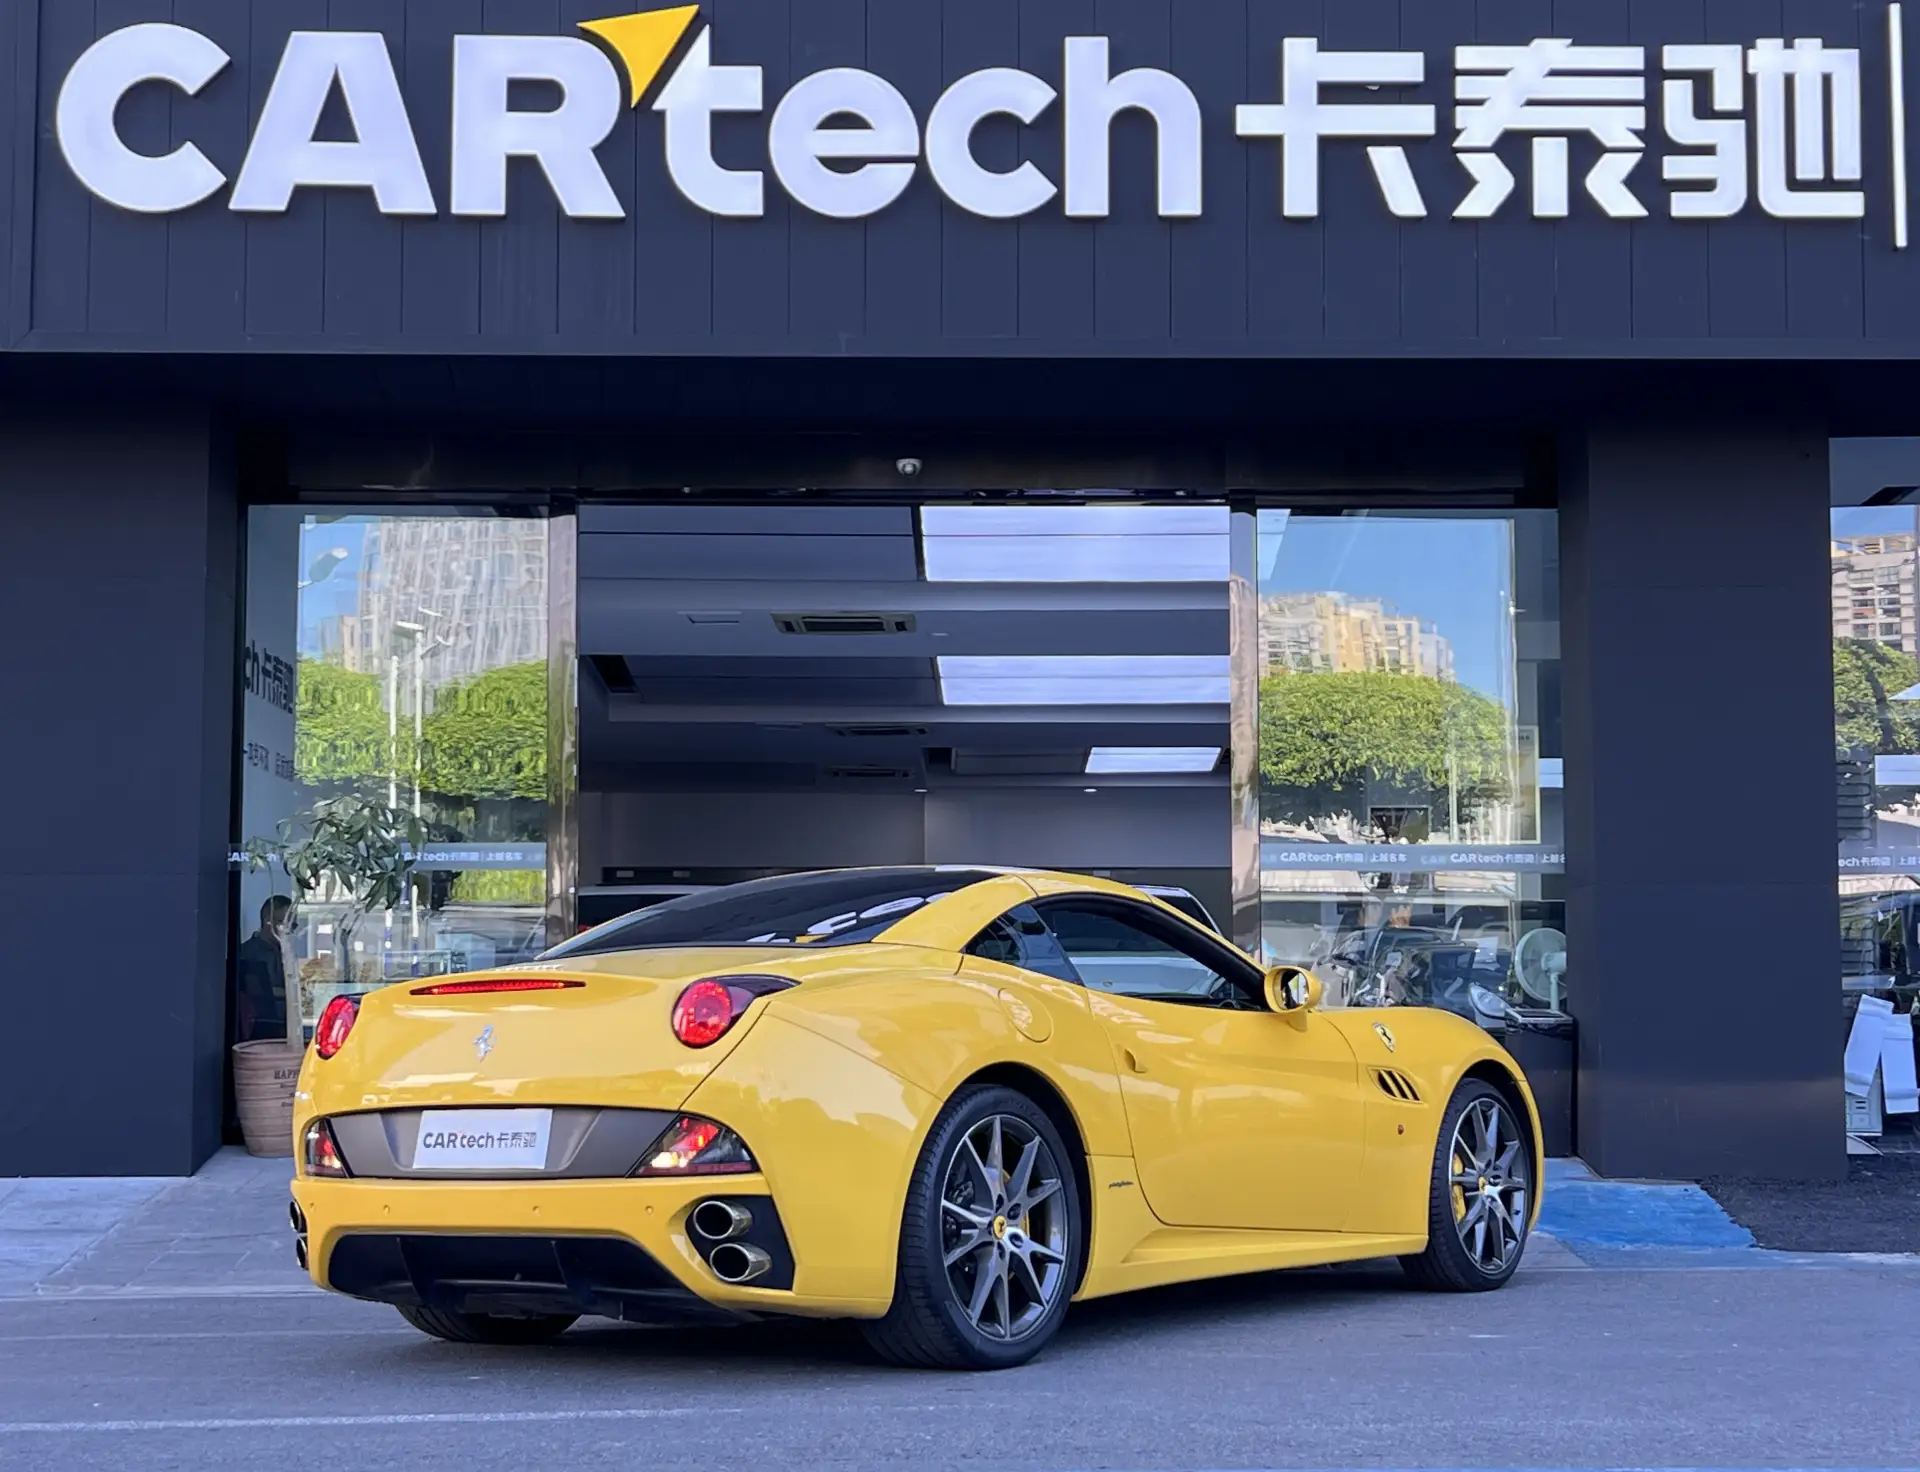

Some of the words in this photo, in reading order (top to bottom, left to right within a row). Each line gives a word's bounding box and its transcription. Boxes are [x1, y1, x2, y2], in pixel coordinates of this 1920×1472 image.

[56, 23, 1202, 218] CARtech
[1236, 36, 1866, 219] 卡泰驰
[423, 1132, 495, 1149] CARtech
[496, 1131, 537, 1149] 卡泰驰
